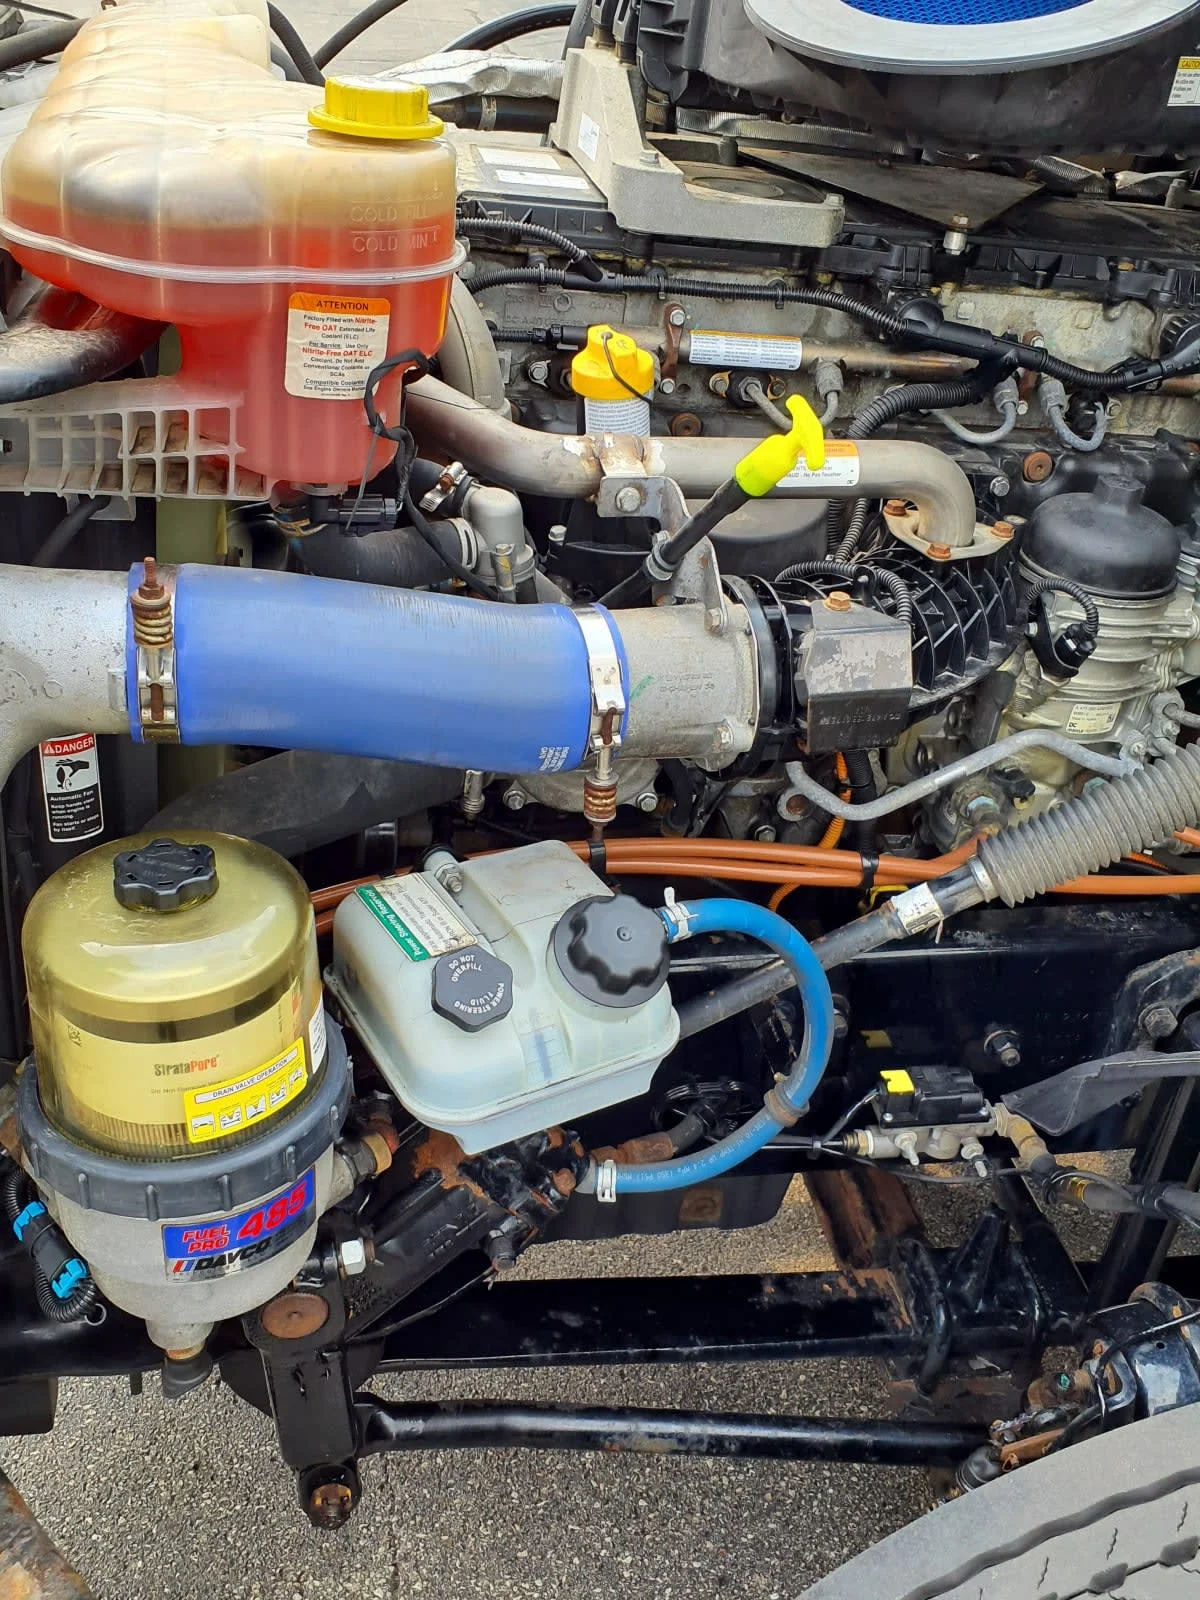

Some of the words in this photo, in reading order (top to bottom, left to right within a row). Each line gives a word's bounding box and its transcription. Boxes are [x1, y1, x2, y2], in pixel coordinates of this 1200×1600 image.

[351, 206, 397, 222] COLD
[352, 235, 398, 252] COLD
[316, 300, 369, 311] ATTENTION
[303, 314, 325, 323] Factory
[354, 317, 378, 325] Nitrite-
[304, 322, 320, 330] Free
[322, 323, 337, 332] OAT
[302, 347, 341, 356] Nitrite-Free
[55, 737, 94, 754] DANGER
[50, 793, 82, 801] Automatic
[364, 888, 390, 915] Reservoir
[386, 914, 409, 938] Steering
[406, 937, 424, 957] Power
[448, 959, 459, 970] DO
[460, 954, 475, 962] NOT
[451, 962, 482, 982] OVERFILL
[470, 991, 494, 1006] FLUID
[490, 983, 504, 1007] POWER
[454, 1000, 491, 1014] STEERING
[154, 1056, 218, 1077] StrataPore
[212, 1085, 234, 1098] DRAIN
[235, 1076, 256, 1091] VALVE
[256, 1058, 288, 1082] OPERATION
[182, 1224, 231, 1243] FUEL
[236, 1180, 307, 1241] 485
[188, 1237, 229, 1253] PRO
[195, 1237, 272, 1270] DAVCO
